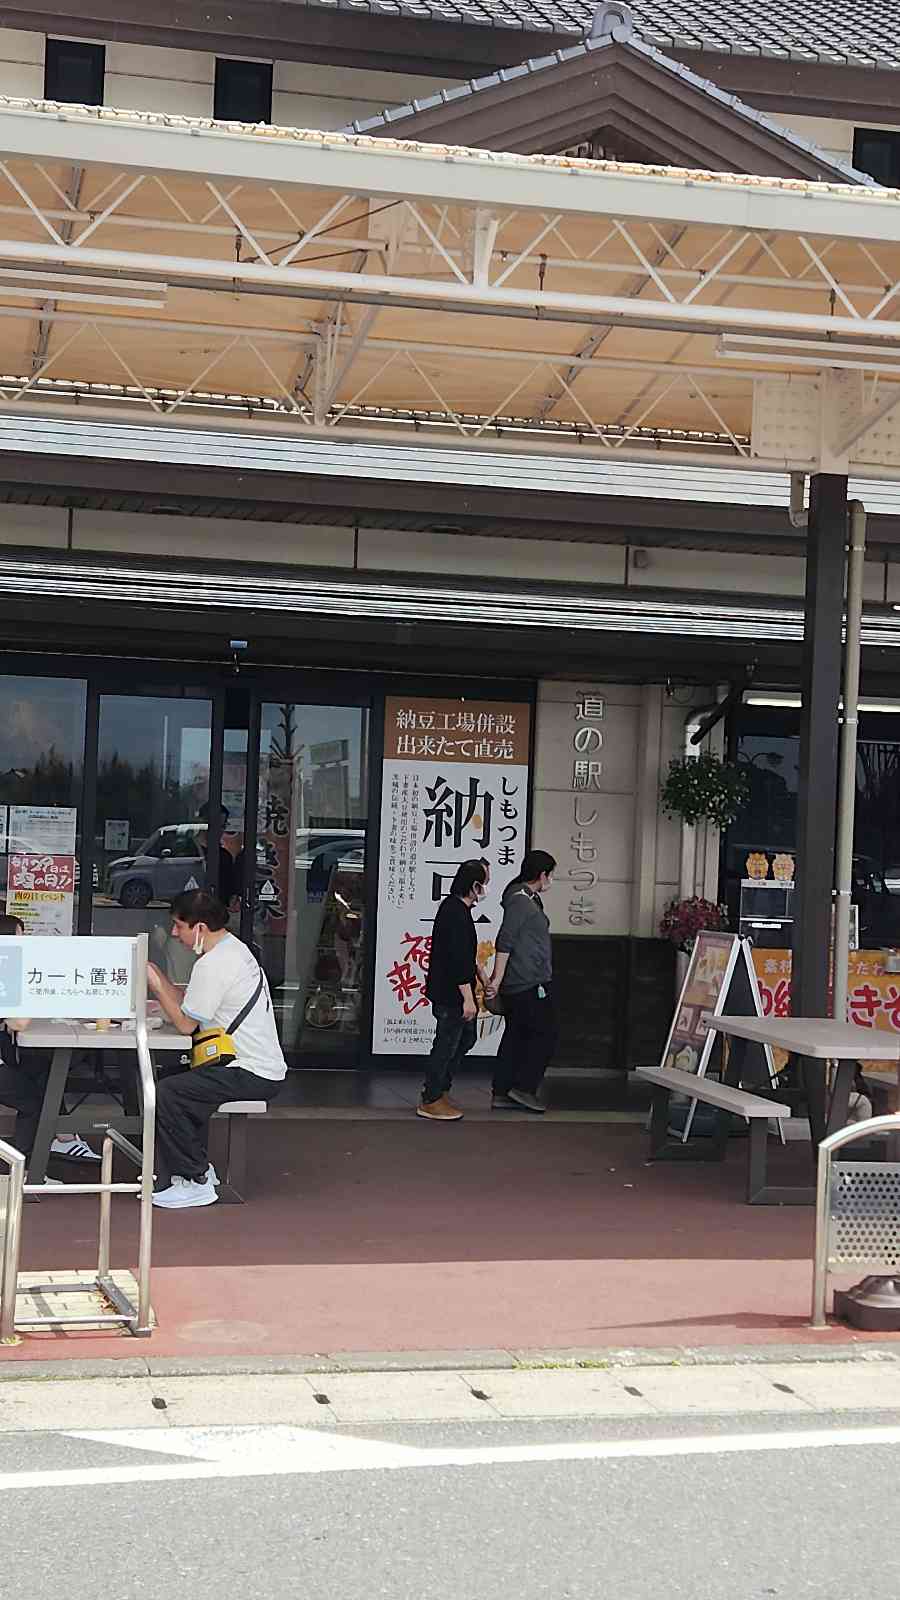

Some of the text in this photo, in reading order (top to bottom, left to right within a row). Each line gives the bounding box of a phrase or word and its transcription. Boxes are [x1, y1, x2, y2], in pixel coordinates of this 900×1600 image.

[395, 708, 516, 735] 納豆工場併設
[396, 735, 515, 760] 出来たて直売
[496, 776, 519, 866] しもつま
[568, 690, 606, 927] 道の駅しもつま
[27, 967, 129, 986] カート置場
